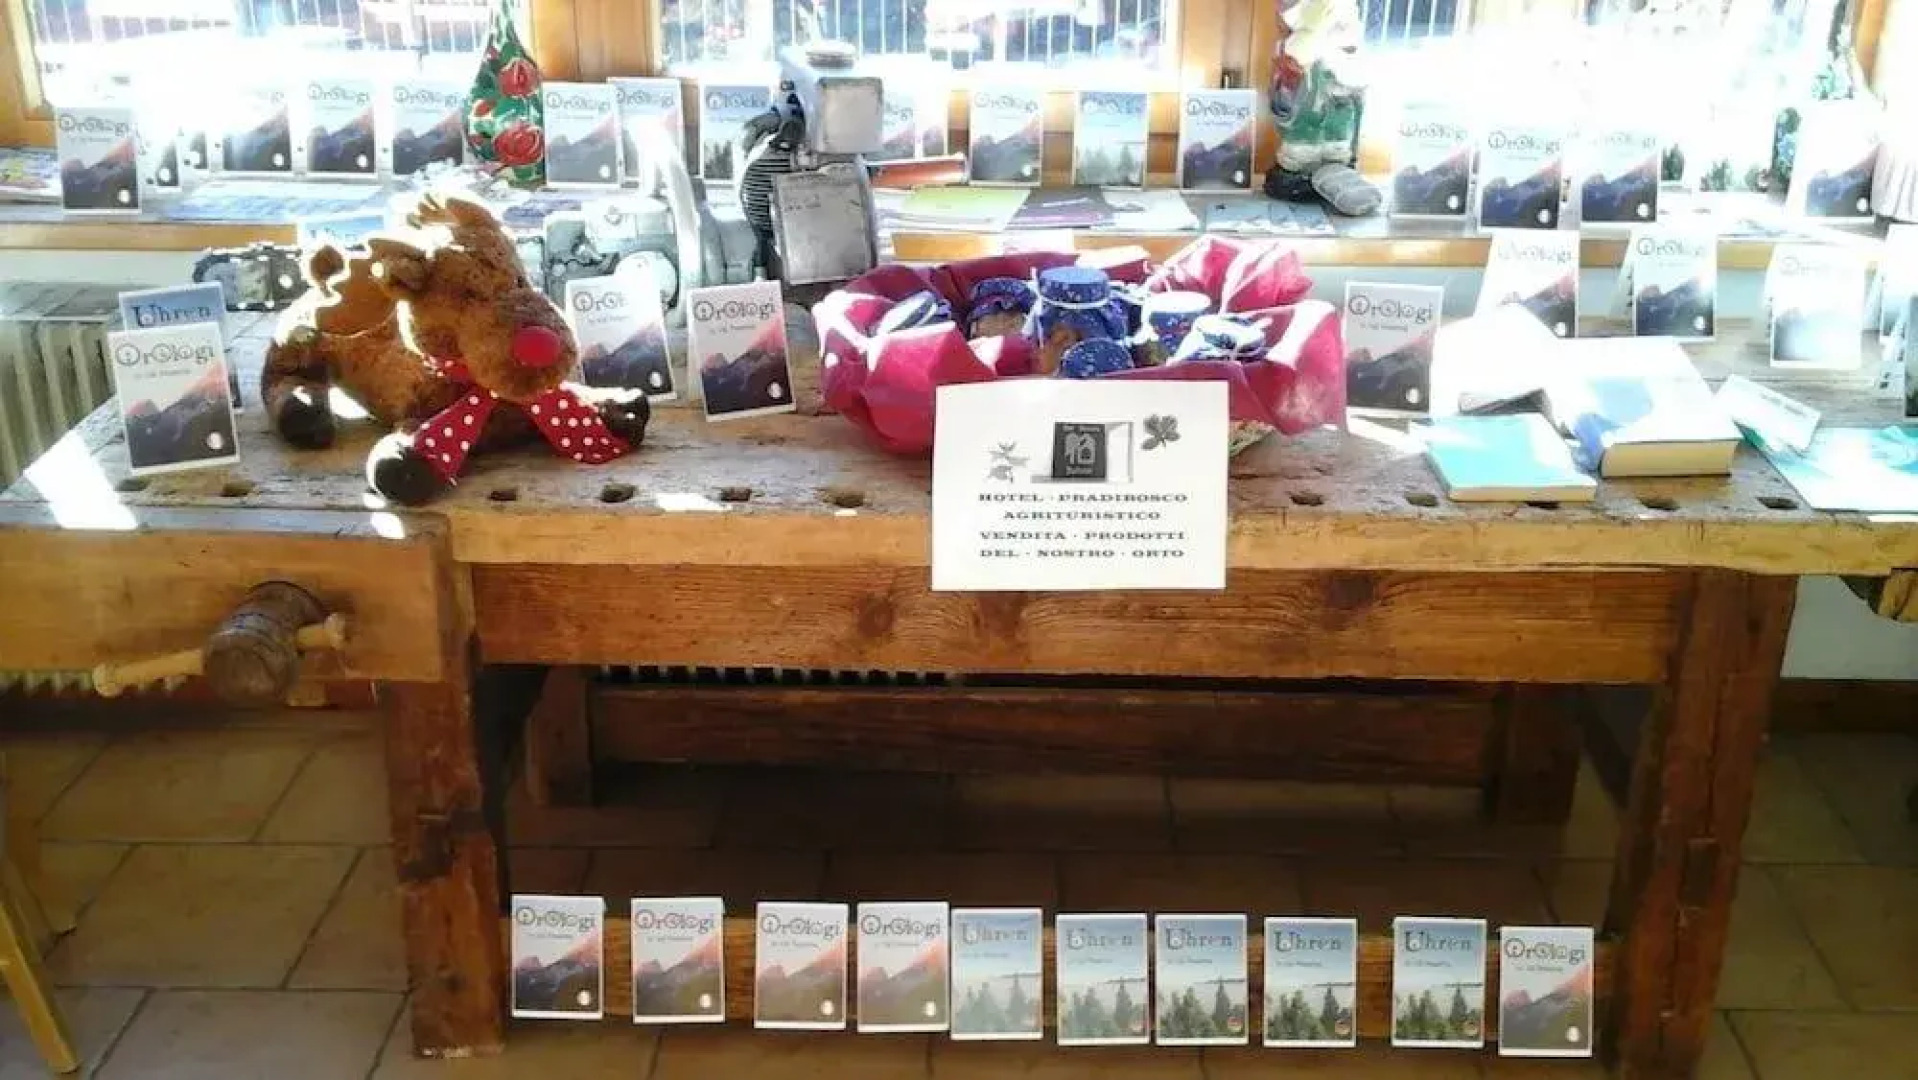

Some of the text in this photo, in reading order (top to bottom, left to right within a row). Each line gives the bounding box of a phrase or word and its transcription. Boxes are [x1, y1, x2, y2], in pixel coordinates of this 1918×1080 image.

[694, 294, 776, 322] Orologi
[1348, 294, 1433, 325] Orologi
[115, 341, 214, 367] Orologi
[979, 492, 1188, 502] HOTEL PRADIBOSCO
[1003, 511, 1160, 521] AGRITURISTICO
[980, 530, 1185, 540] VENDITA PRODOTTI
[980, 549, 1185, 558] DEL NOSTRO ORTO
[517, 906, 596, 933] Orologi
[635, 909, 715, 934] Orologi
[761, 913, 841, 938] Orologi
[860, 914, 940, 938] Orologi
[1273, 929, 1342, 952] Uhren
[1504, 936, 1585, 965] Orologi
